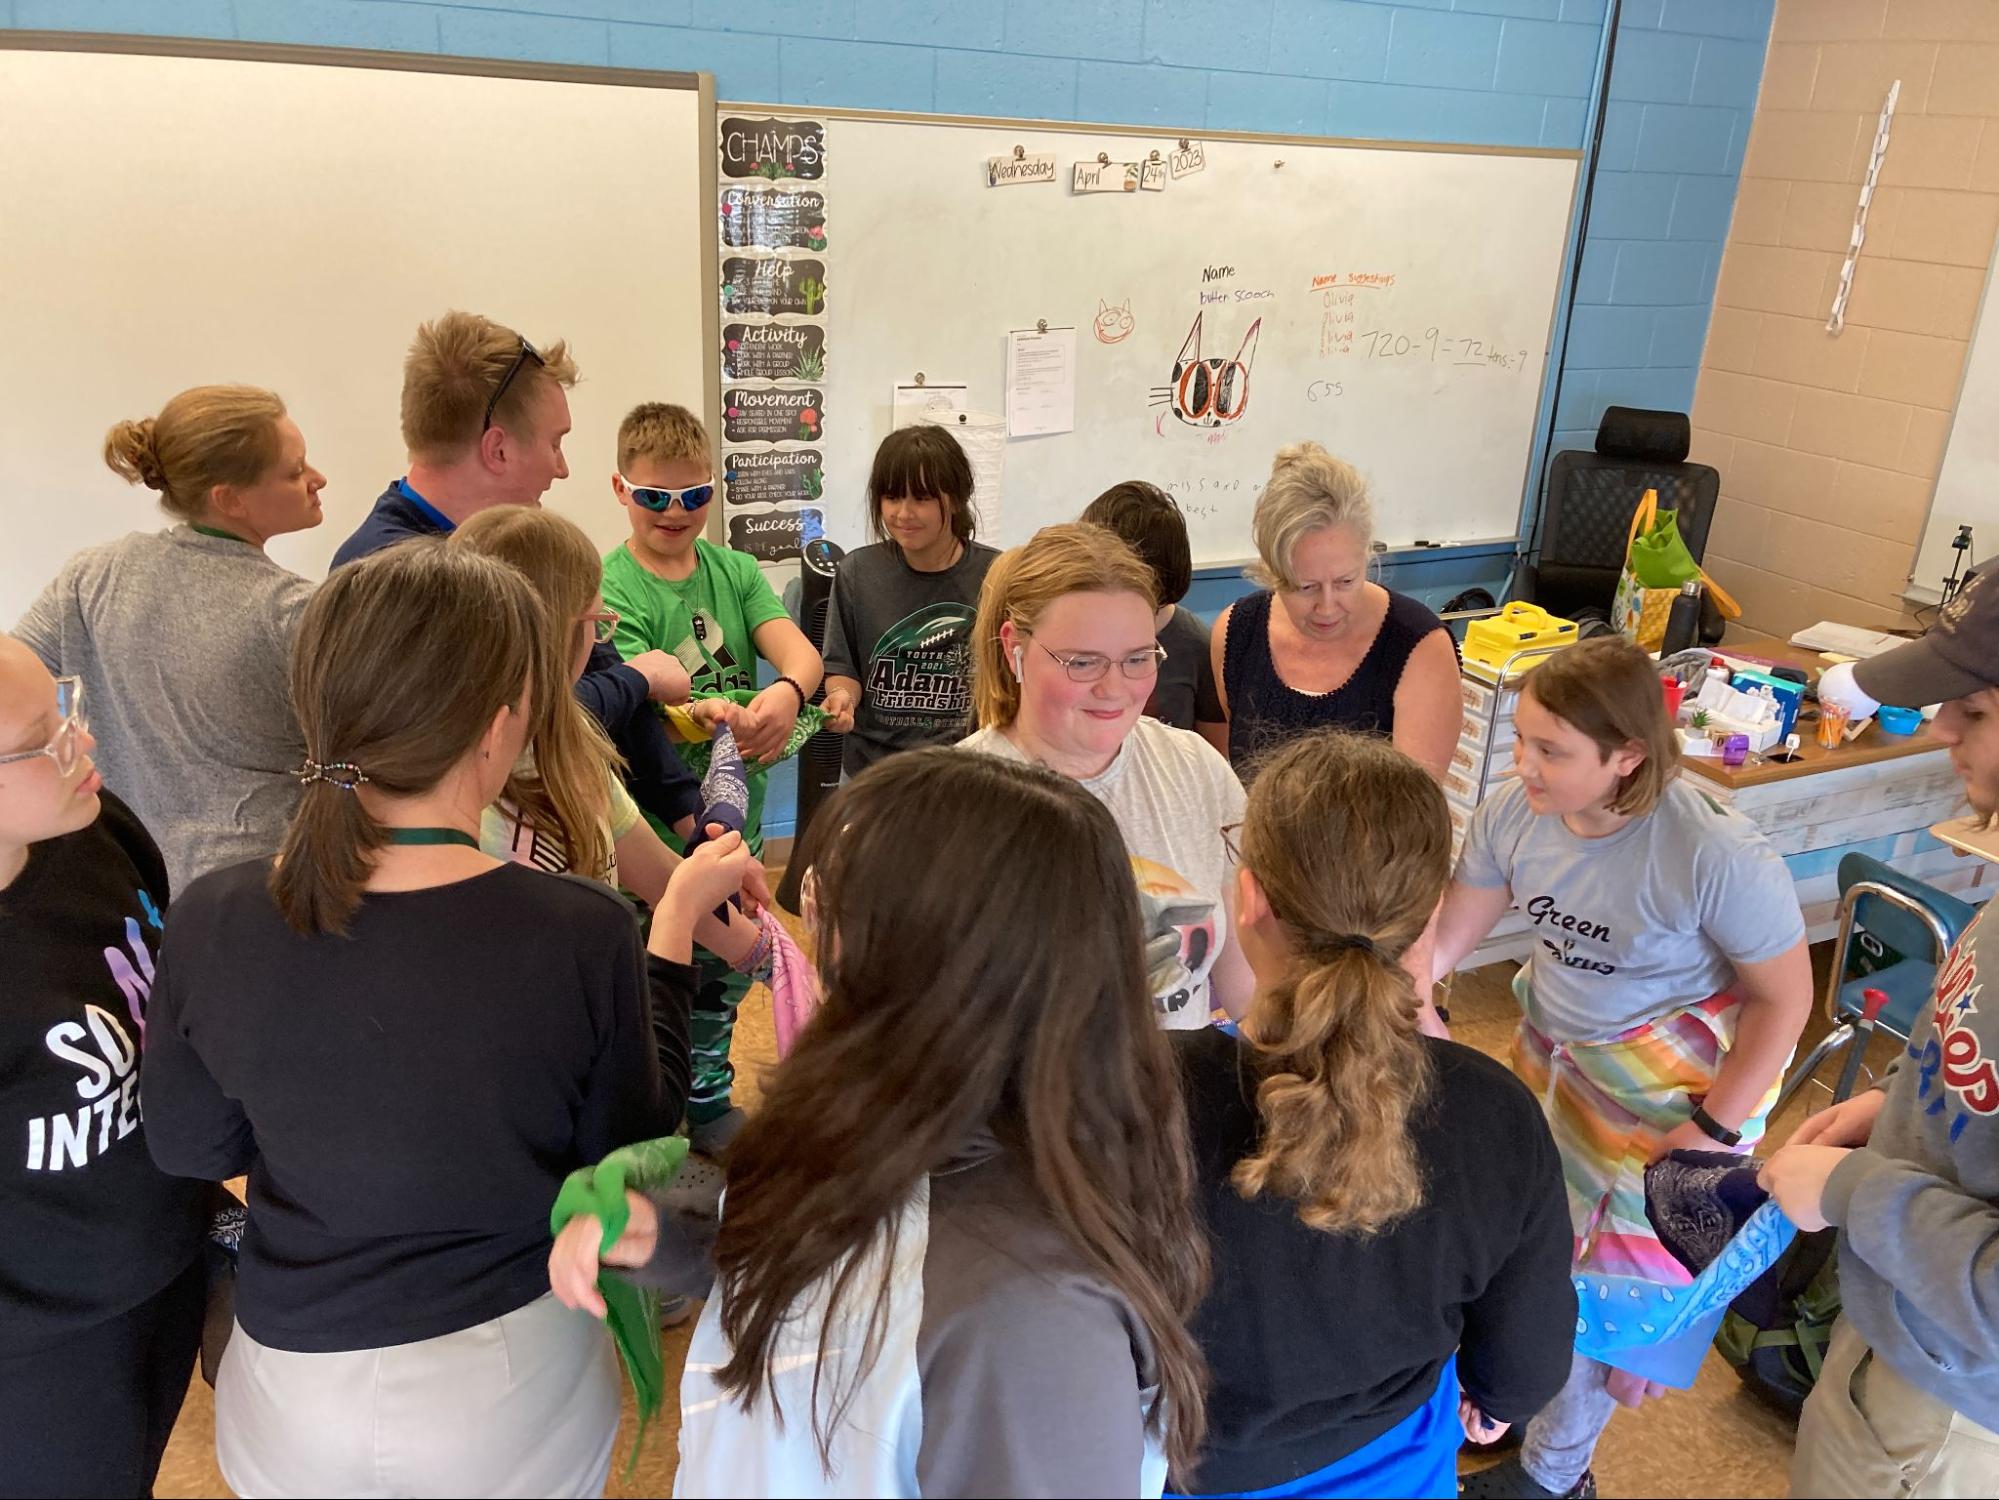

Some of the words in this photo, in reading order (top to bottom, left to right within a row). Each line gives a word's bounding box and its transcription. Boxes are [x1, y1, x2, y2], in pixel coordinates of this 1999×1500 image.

[727, 131, 819, 165] CHAMPS
[989, 161, 1054, 181] Wednesday
[1172, 151, 1201, 173] 2023
[1076, 167, 1100, 189] April
[727, 190, 820, 208] Conversation
[754, 260, 795, 282] Help
[1202, 265, 1236, 283] Name
[1311, 274, 1337, 287] Name
[742, 326, 808, 349] Activity
[735, 390, 815, 407] Movement
[732, 453, 817, 469] Participation
[745, 518, 806, 534] Success
[906, 651, 943, 660] YOUTH
[920, 662, 943, 670] 2021
[875, 691, 973, 712] Friendship
[1527, 895, 1611, 942] Green
[26, 1071, 144, 1171] INTE
